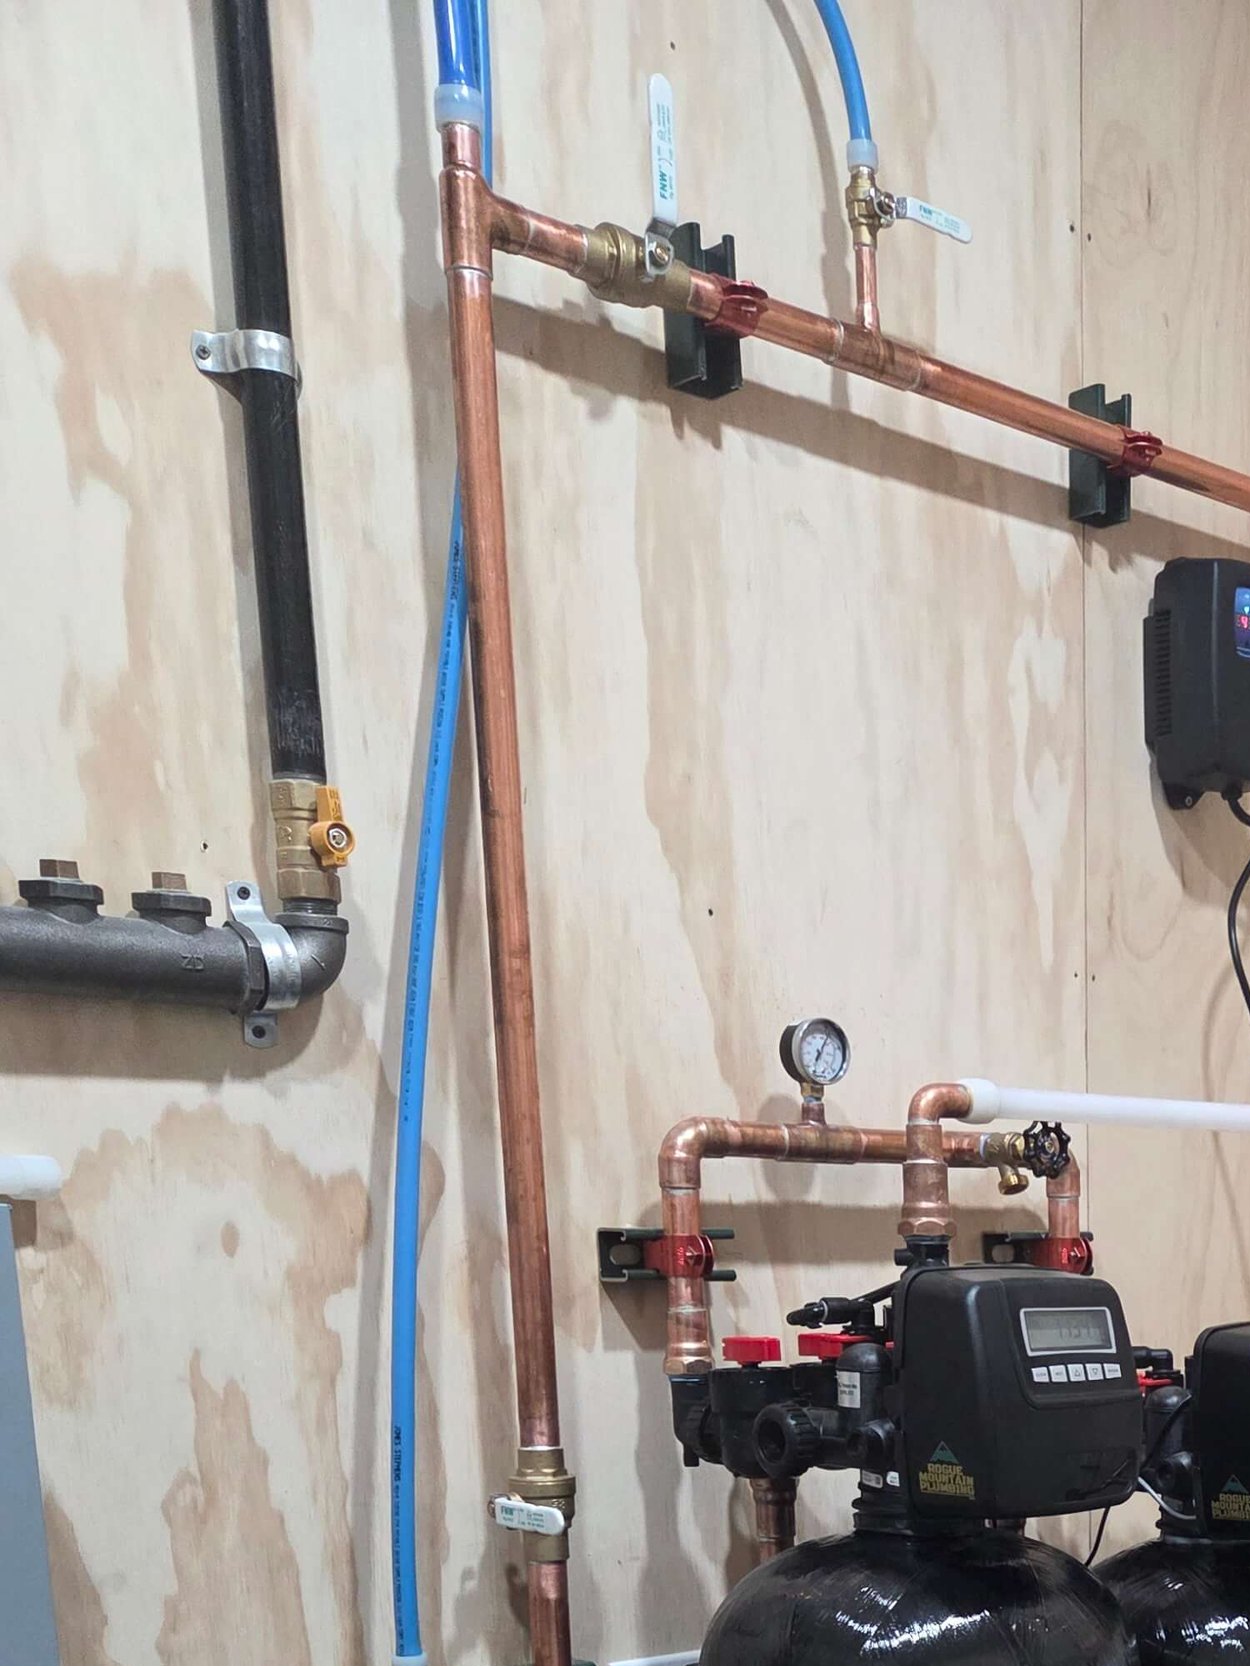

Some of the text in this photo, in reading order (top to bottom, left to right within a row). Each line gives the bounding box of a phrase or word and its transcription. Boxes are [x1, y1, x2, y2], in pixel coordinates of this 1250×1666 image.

[659, 170, 668, 200] FNW
[394, 1425, 402, 1446] JONES
[394, 1448, 402, 1482] STEPHENS
[927, 1463, 964, 1475] ROGUE
[918, 1471, 975, 1486] MOUNTAIN
[919, 1480, 976, 1496] PLUMBING
